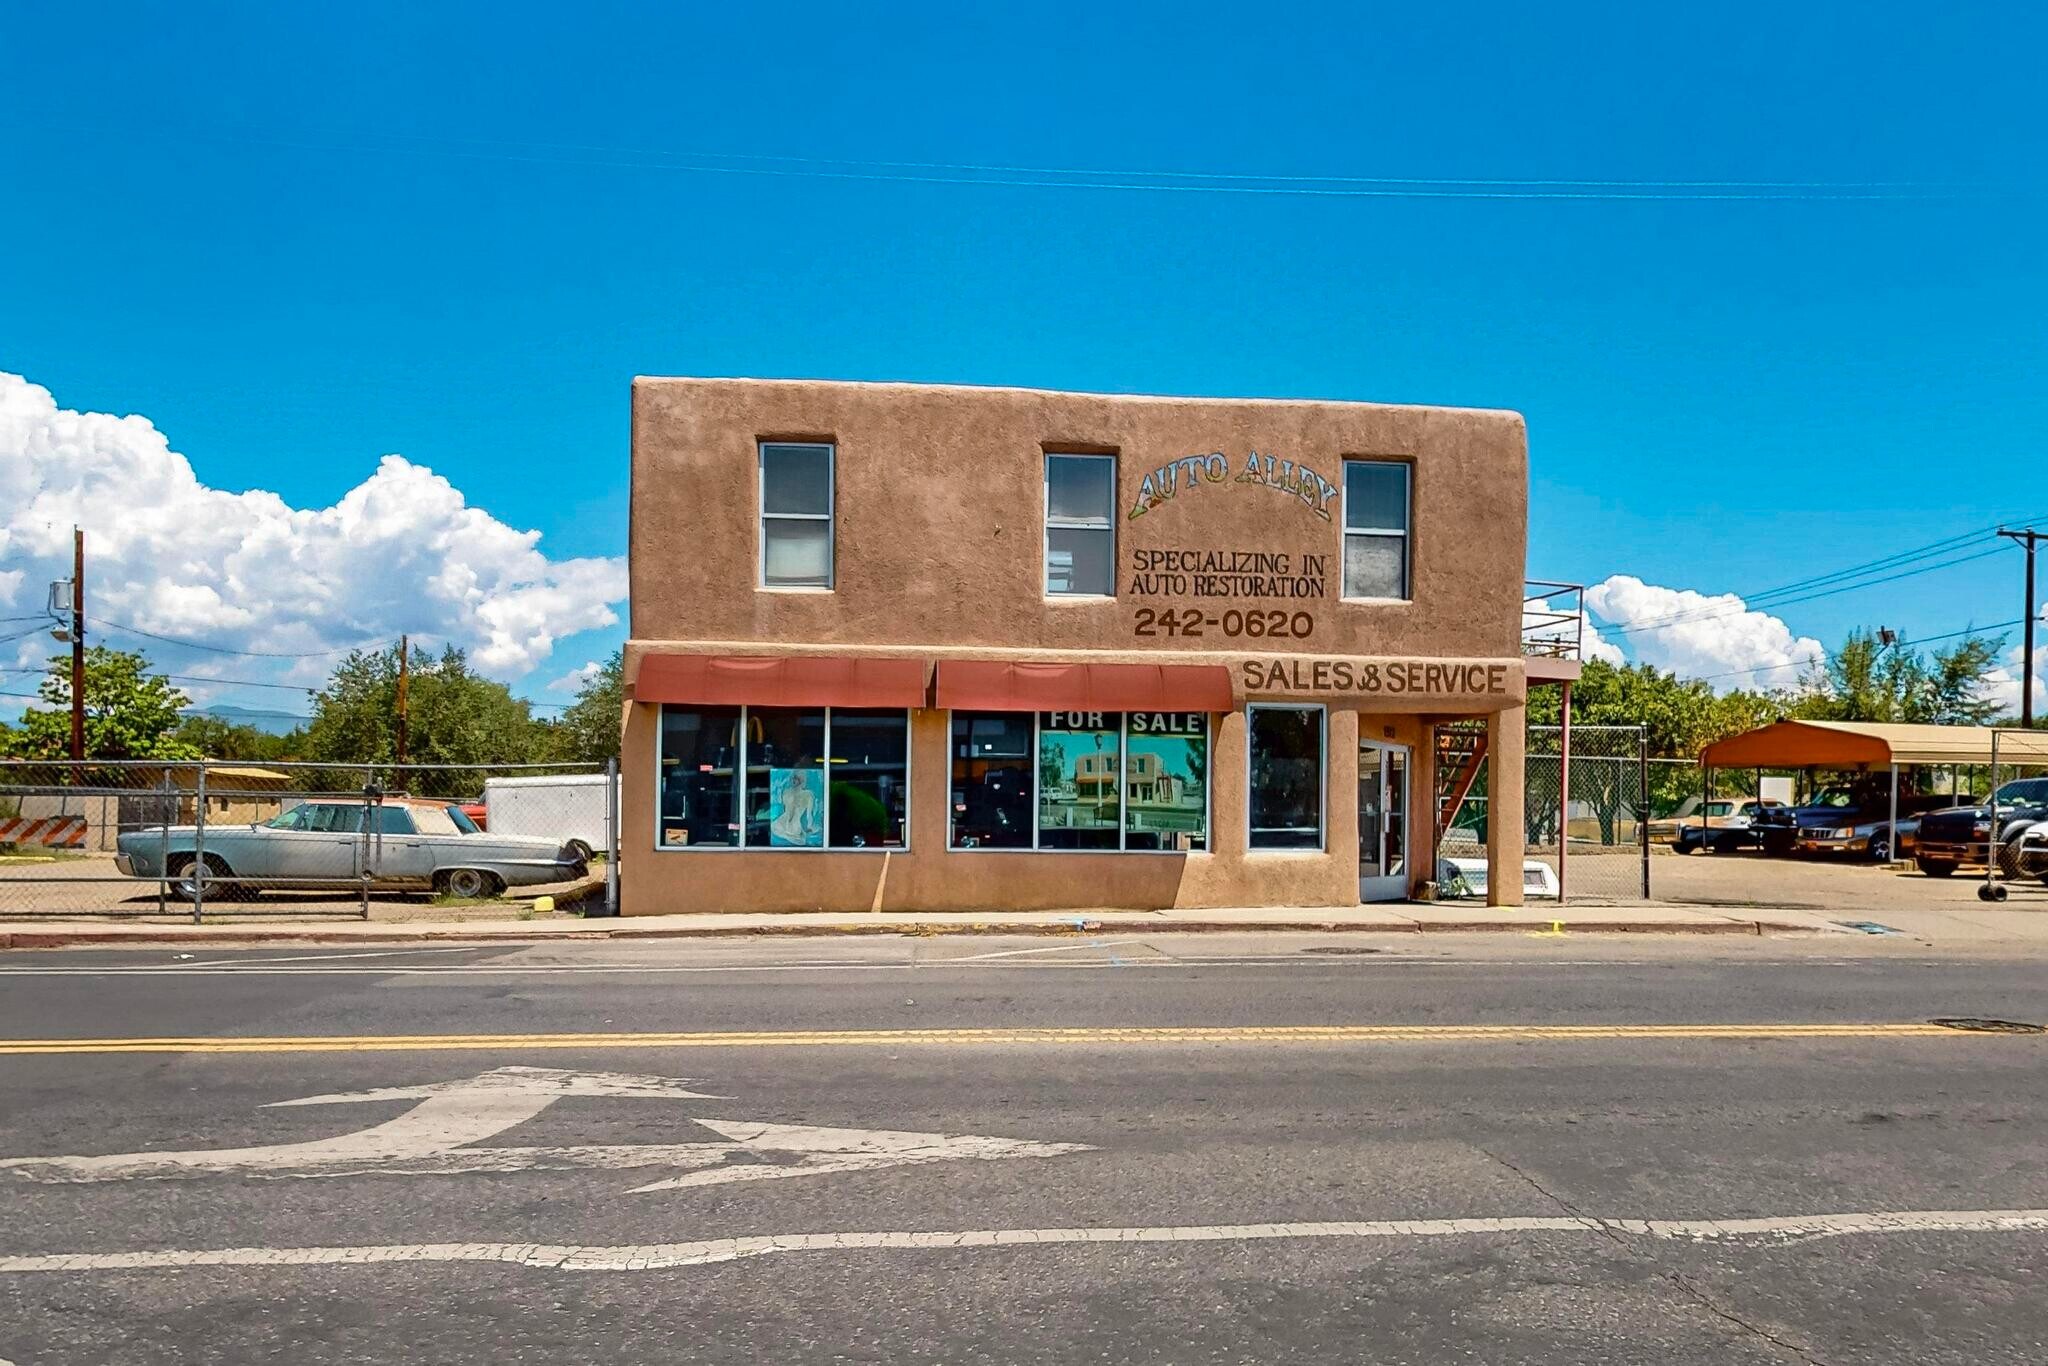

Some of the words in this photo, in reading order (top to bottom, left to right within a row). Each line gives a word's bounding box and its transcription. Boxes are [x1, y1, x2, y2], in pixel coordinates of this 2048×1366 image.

[1128, 452, 1228, 521] AUTO
[1236, 450, 1338, 522] ALLEY
[1132, 550, 1290, 574] SPECIALIZING
[1302, 555, 1325, 574] IN
[1130, 575, 1187, 596] AUTO
[1193, 575, 1325, 598] RESTORATION
[1134, 608, 1314, 638] 242-0620
[1242, 660, 1354, 691] SALES
[1386, 663, 1508, 694] SERVICE
[1051, 712, 1104, 728] FOR
[1132, 713, 1200, 732] SALE
